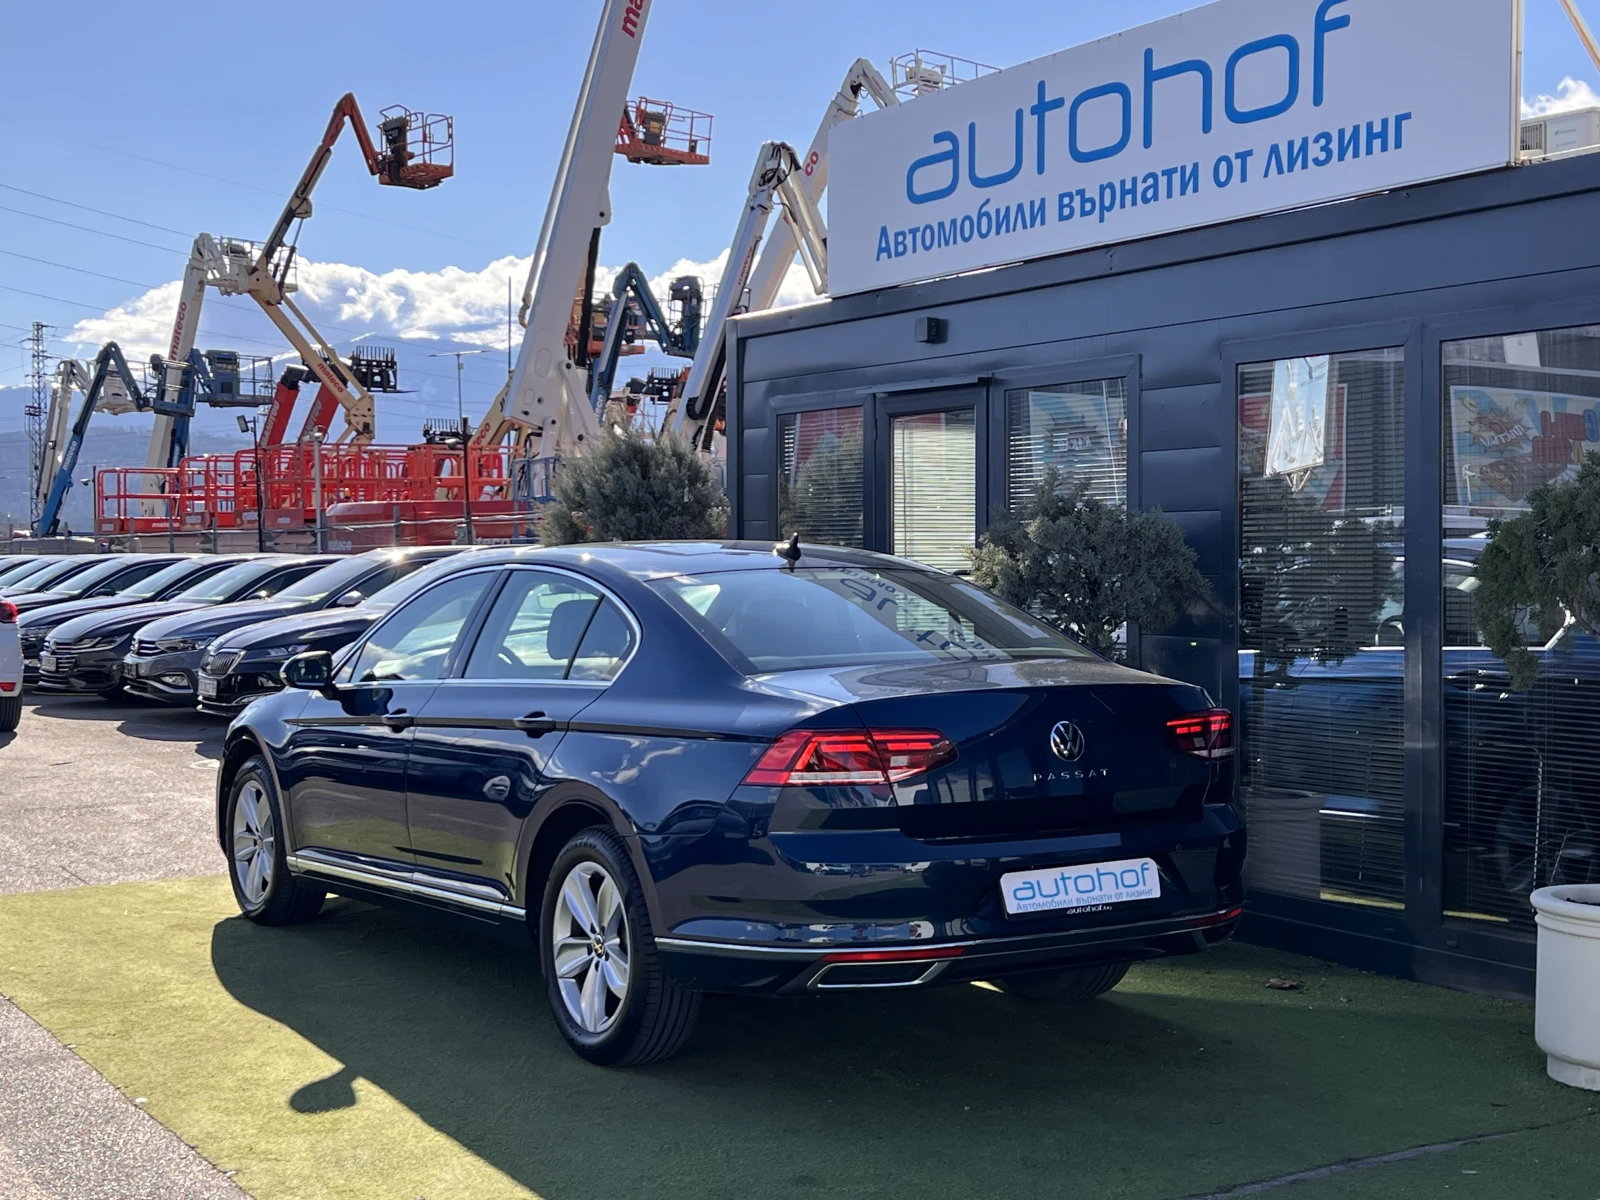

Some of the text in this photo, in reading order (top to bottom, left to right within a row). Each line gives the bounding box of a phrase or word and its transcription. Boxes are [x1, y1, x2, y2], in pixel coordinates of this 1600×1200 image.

[906, 0, 1351, 206] autohof
[876, 111, 1412, 262] Автомобили върнати от лизинг
[170, 301, 187, 361] mateco
[317, 363, 344, 393] mateco
[1033, 768, 1109, 782] PASSAT
[1012, 862, 1150, 901] autohof
[1016, 888, 1154, 912] Автомобили върнати от лизинг
